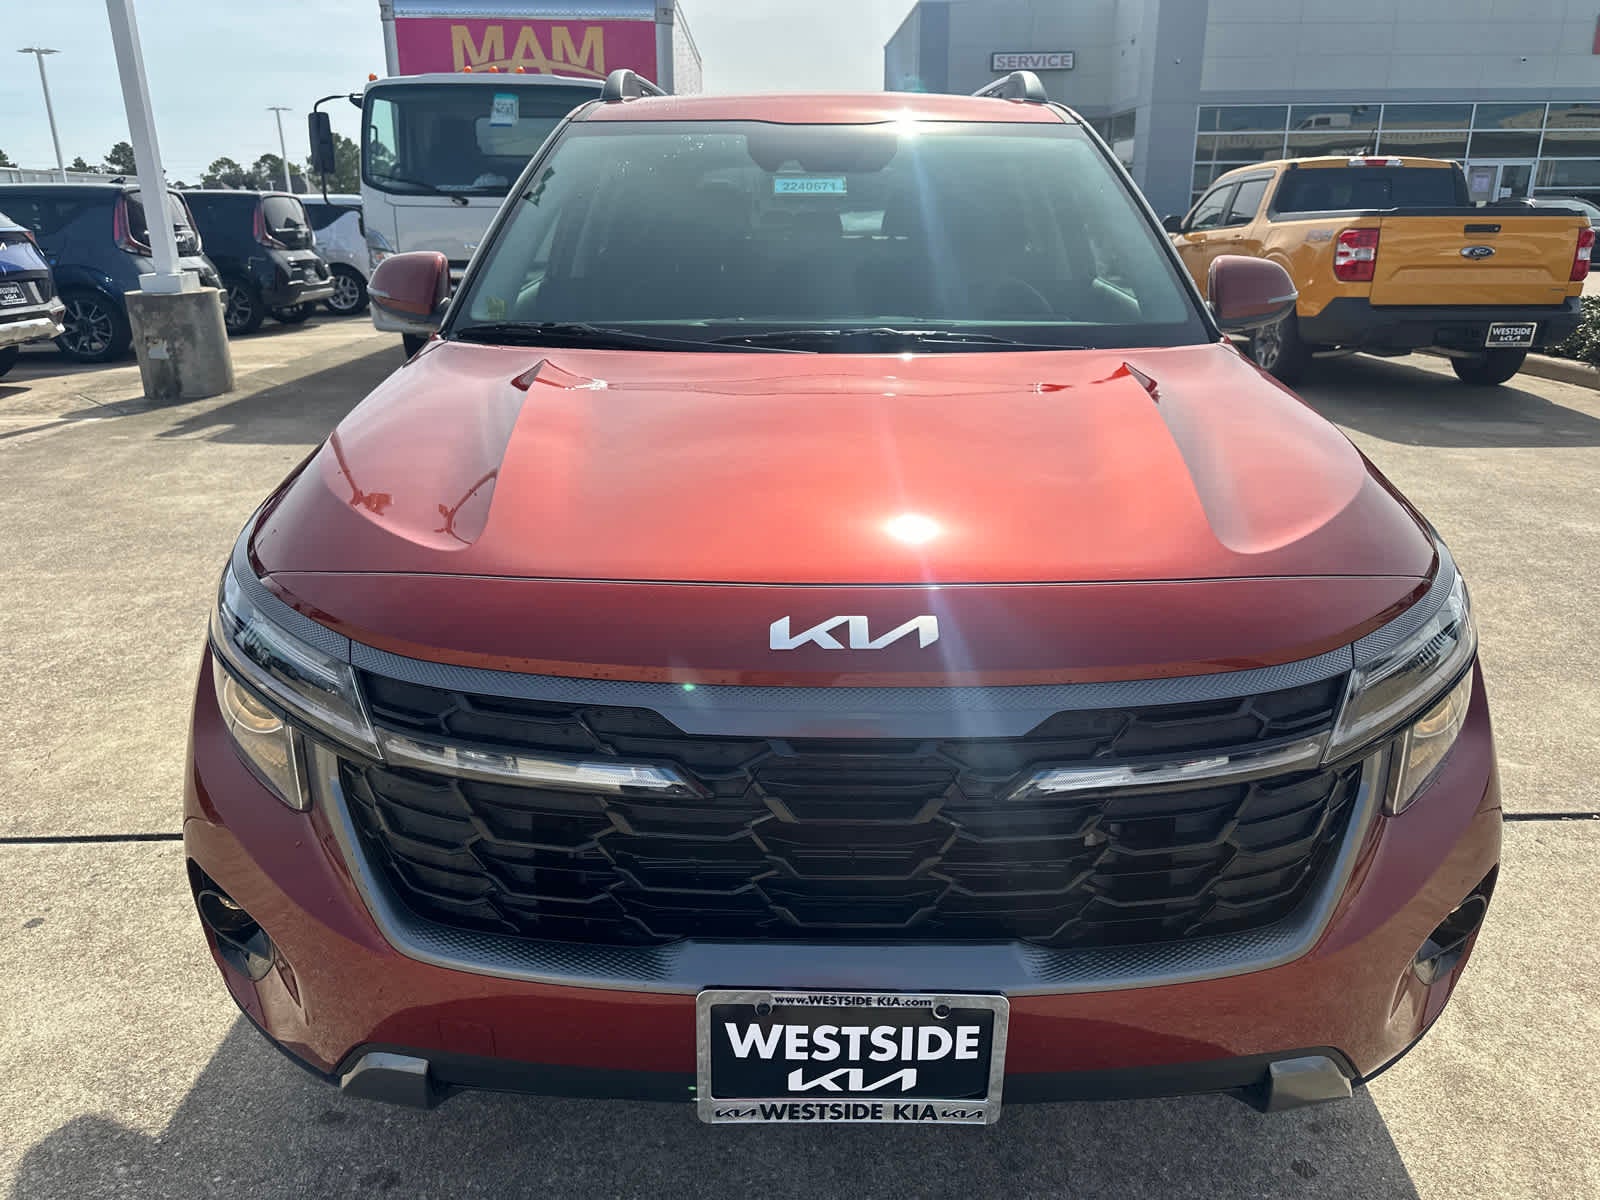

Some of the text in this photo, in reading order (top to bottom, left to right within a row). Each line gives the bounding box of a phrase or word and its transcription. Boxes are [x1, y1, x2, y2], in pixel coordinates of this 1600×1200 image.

[450, 24, 606, 74] MAM
[995, 54, 1072, 68] SERVICE
[1492, 327, 1532, 336] WESTSIDE
[769, 615, 940, 650] KIA
[774, 995, 932, 1007] www.WESTSIDE KIA.com
[724, 1022, 981, 1062] WESTSIDE
[787, 1067, 918, 1092] KIA
[759, 1103, 883, 1121] WESTSIDE
[892, 1104, 939, 1121] KIA
